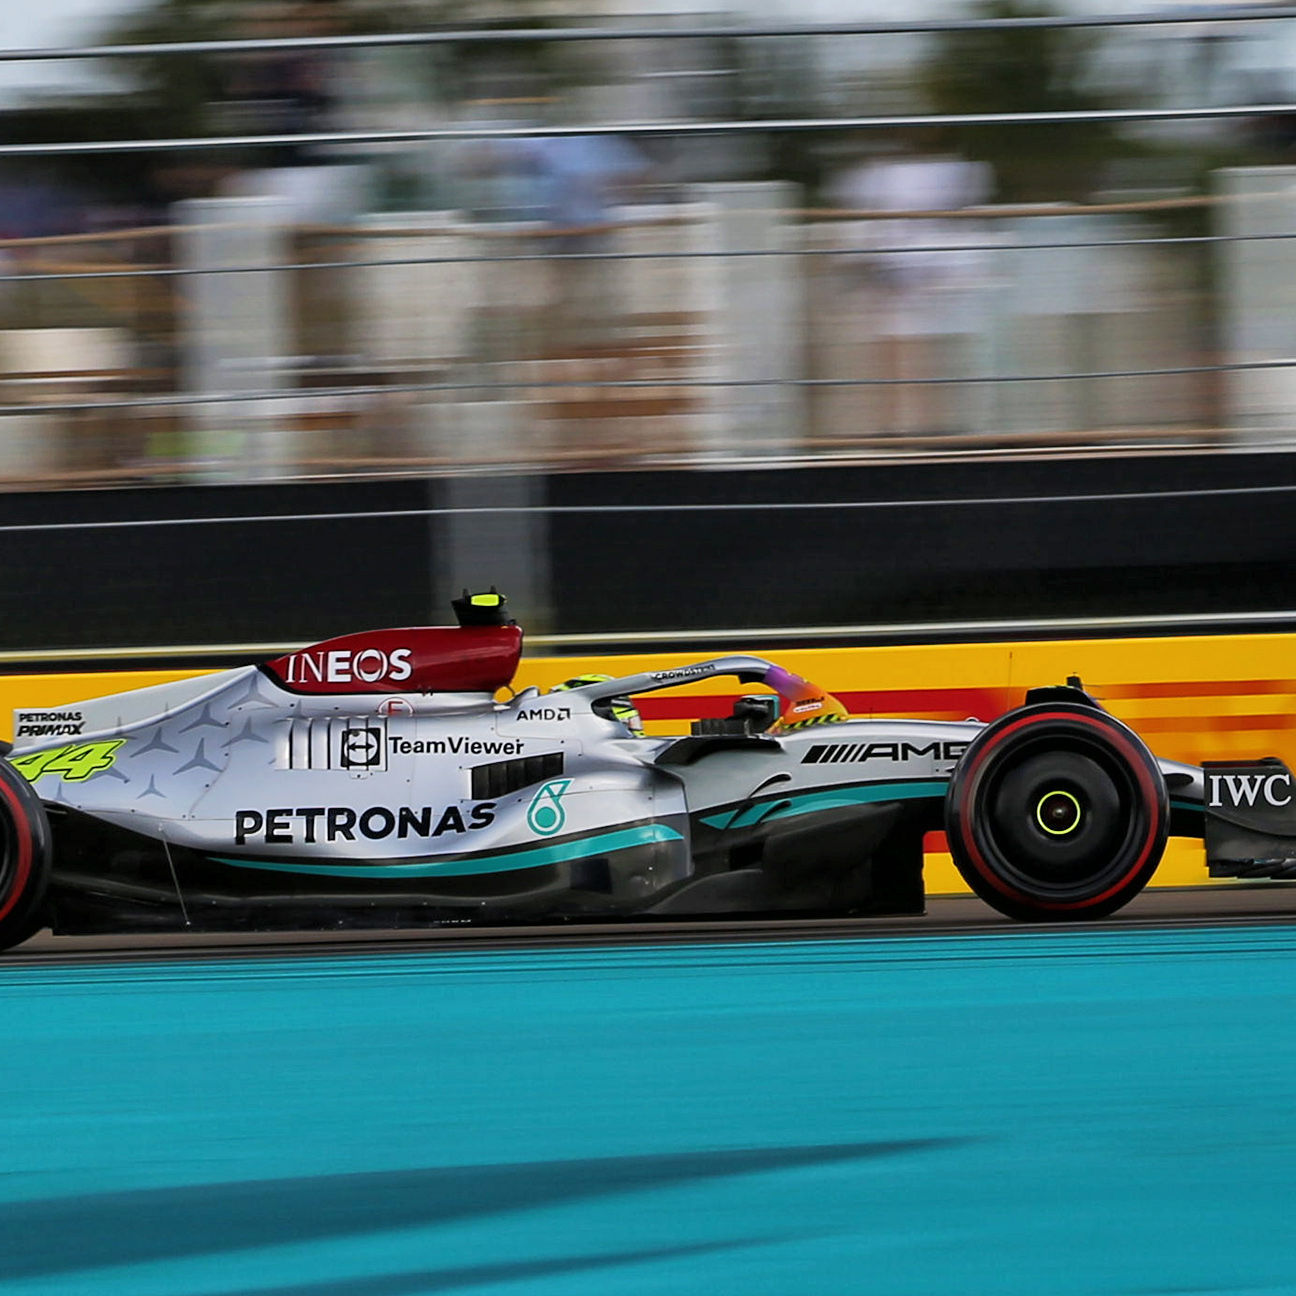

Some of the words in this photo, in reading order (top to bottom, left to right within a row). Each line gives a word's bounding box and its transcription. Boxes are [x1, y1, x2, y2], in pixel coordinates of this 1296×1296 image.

[284, 648, 413, 683] INEOS
[18, 711, 83, 723] PETRONAS
[516, 708, 556, 721] AMD
[16, 720, 86, 737] PRIMAX
[388, 736, 524, 755] TeamViewer
[857, 741, 972, 763] AMG
[8, 738, 128, 784] 44
[1208, 773, 1292, 807] IWC
[235, 802, 498, 846] PETRONAS
